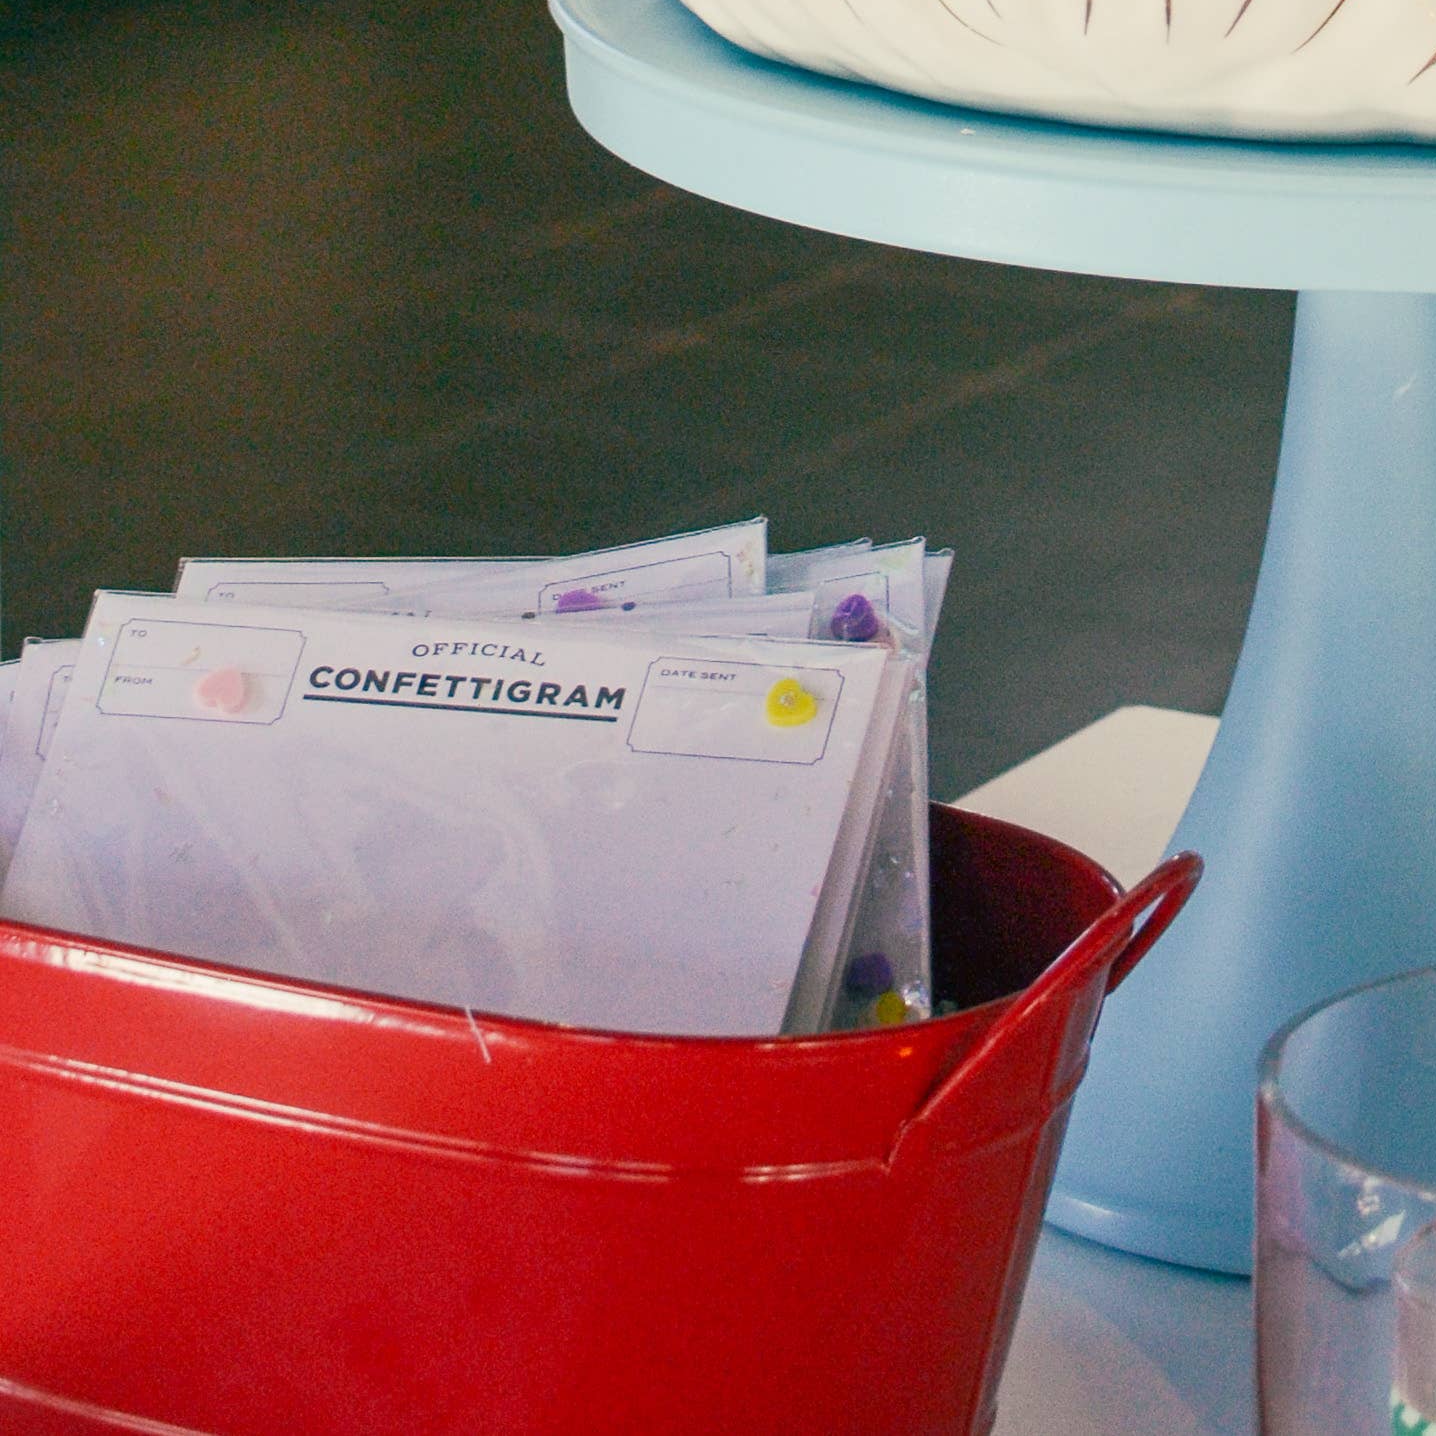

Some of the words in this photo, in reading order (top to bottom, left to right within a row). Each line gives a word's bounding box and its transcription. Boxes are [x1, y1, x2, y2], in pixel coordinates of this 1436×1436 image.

[590, 579, 627, 594] SENT
[130, 628, 148, 639] TO
[411, 641, 547, 667] OFFICIAL
[114, 674, 153, 687] FROM
[659, 668, 698, 680] DATE
[700, 671, 737, 683] SENT
[309, 665, 627, 711] CONFETTIGRAM
